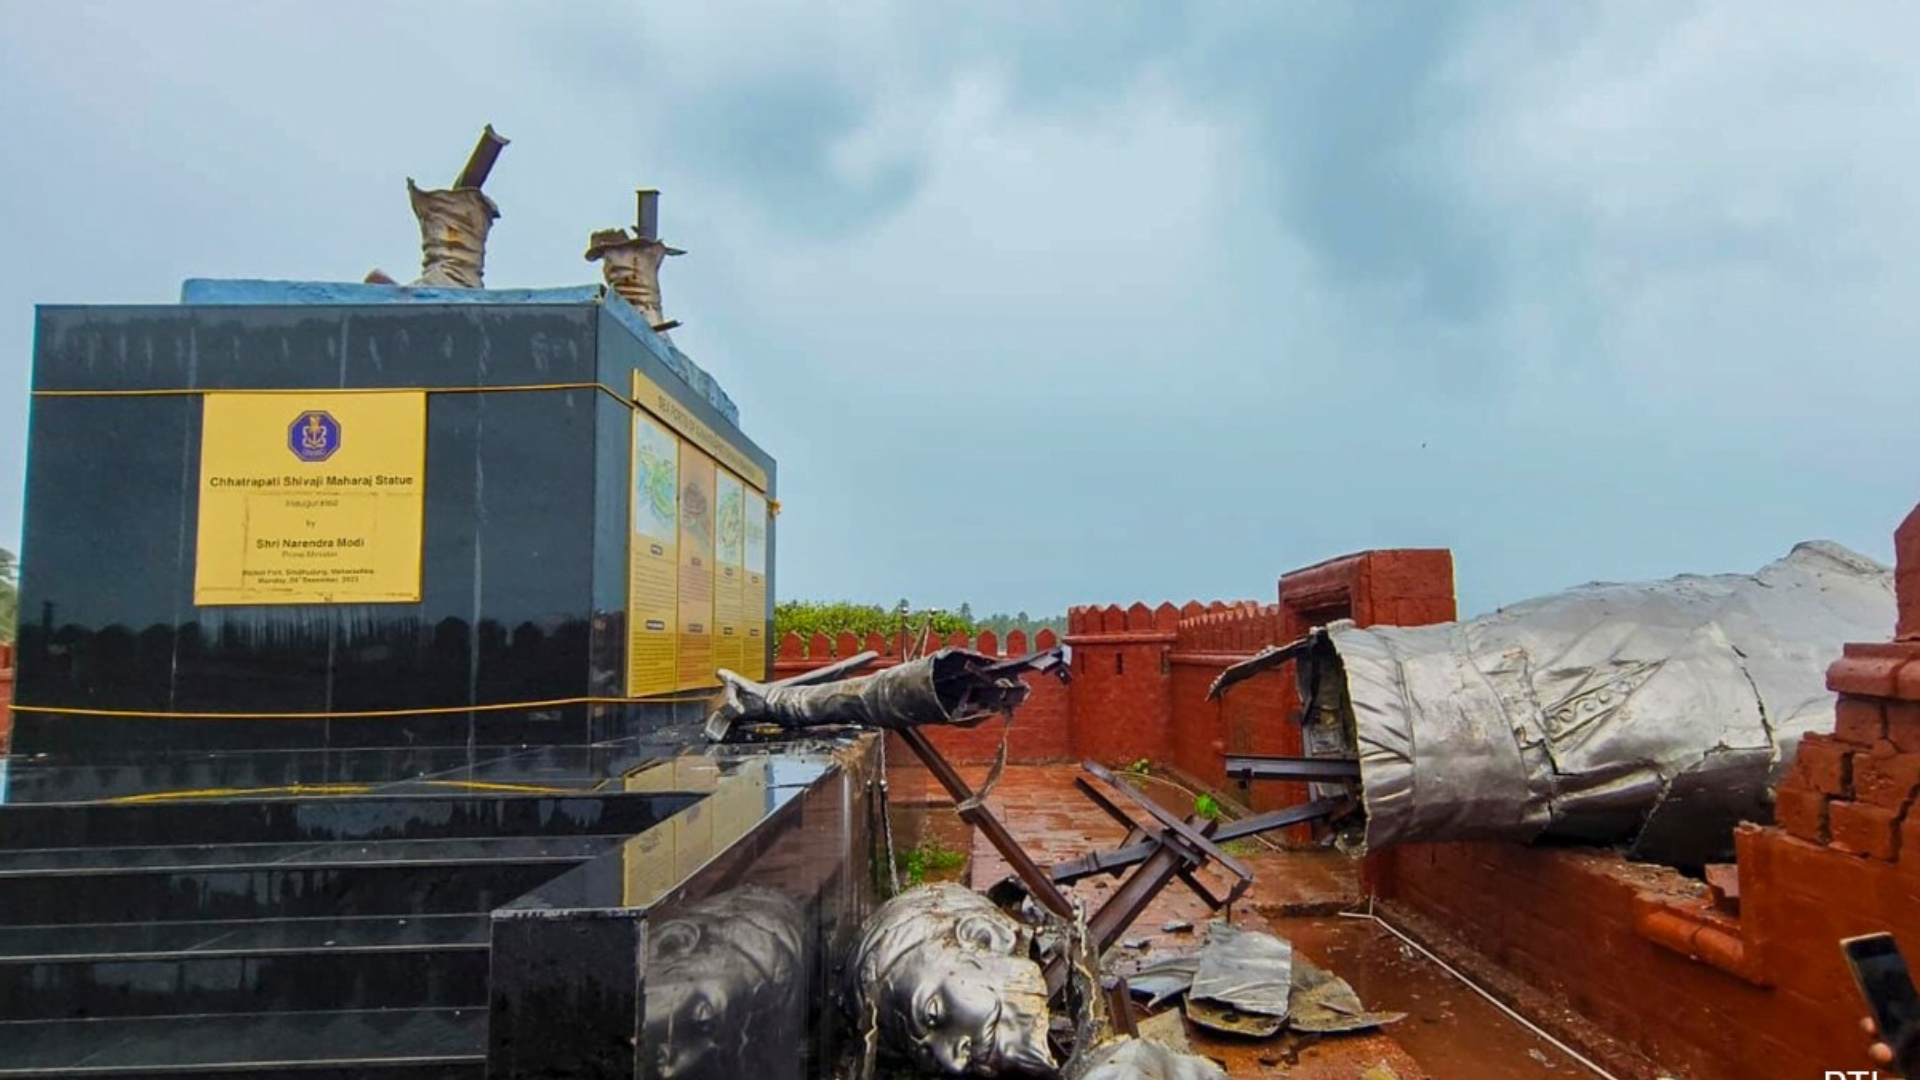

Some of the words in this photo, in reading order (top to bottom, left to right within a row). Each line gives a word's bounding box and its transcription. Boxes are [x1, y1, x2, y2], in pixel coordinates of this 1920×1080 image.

[209, 476, 281, 488] Chhatrapati
[283, 475, 324, 488] Shivaji
[326, 475, 373, 488] Maharaj
[375, 474, 414, 486] Statue
[256, 538, 280, 549] Shri
[282, 538, 334, 549] Narendra
[336, 537, 364, 548] Modi
